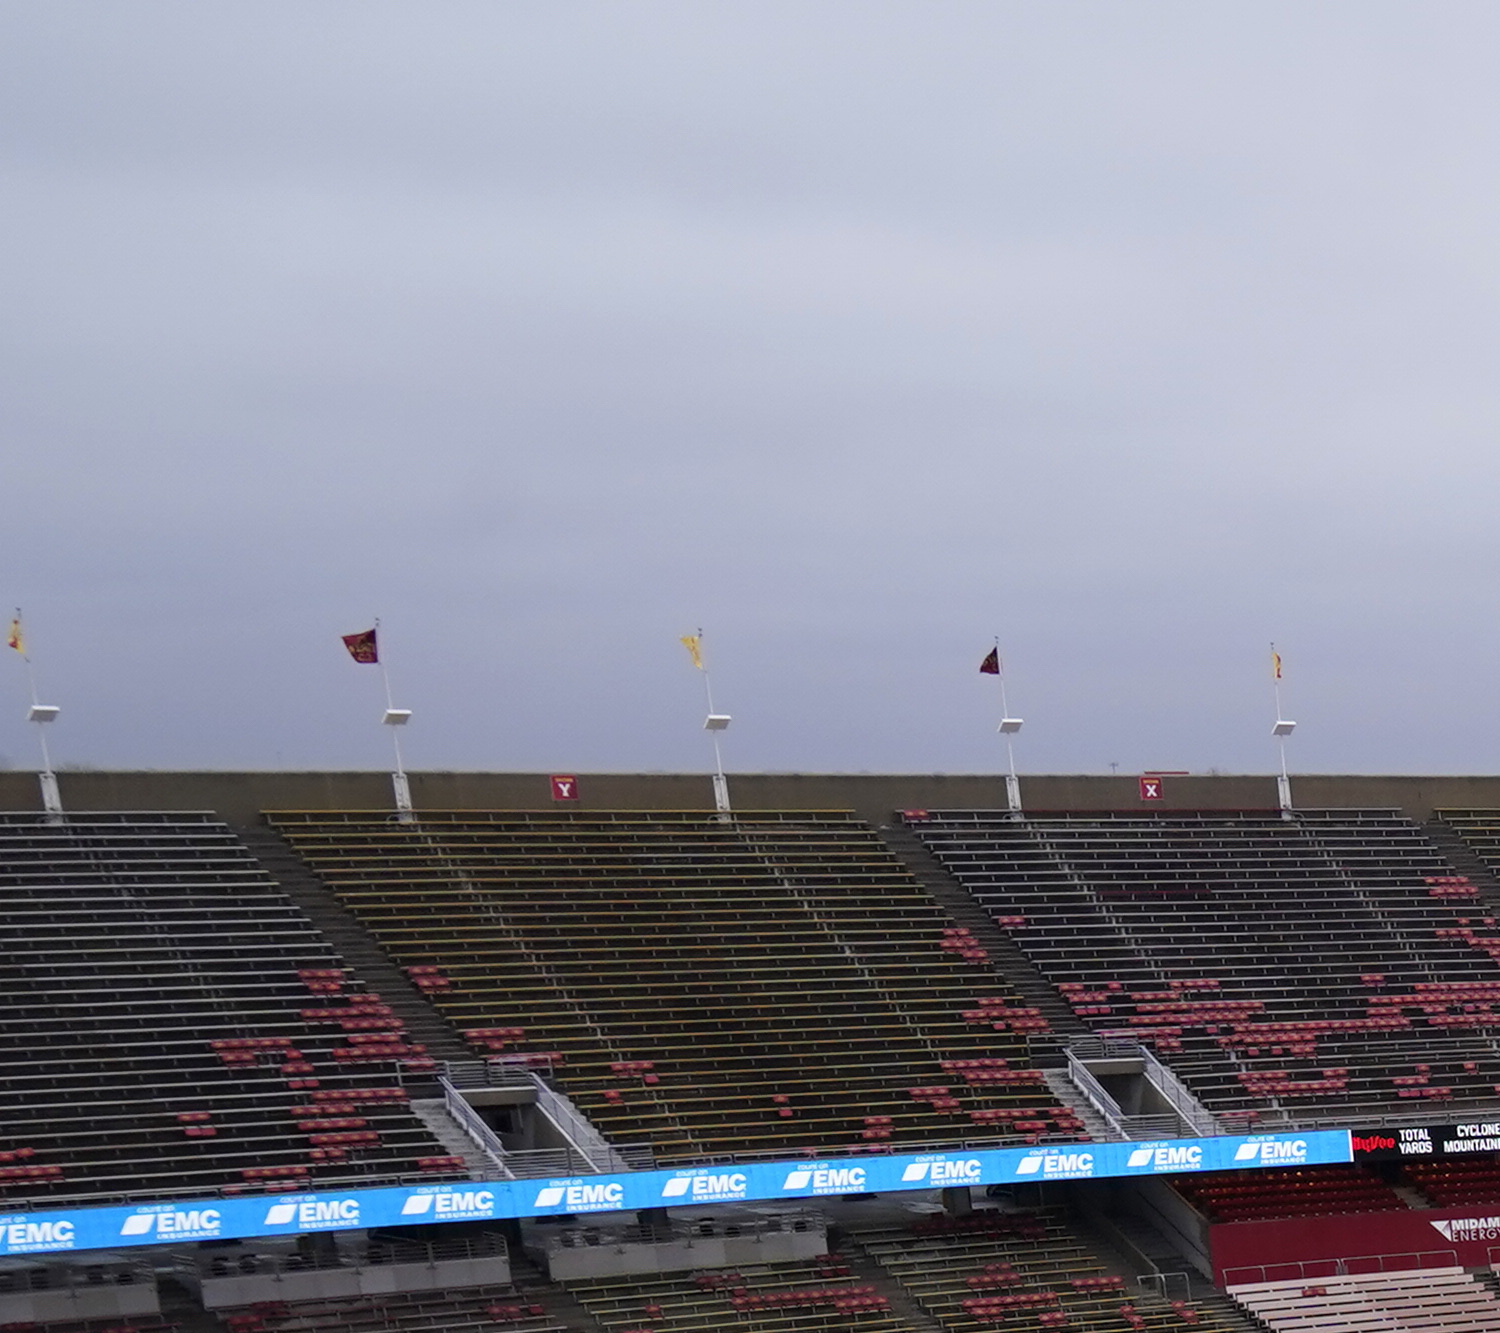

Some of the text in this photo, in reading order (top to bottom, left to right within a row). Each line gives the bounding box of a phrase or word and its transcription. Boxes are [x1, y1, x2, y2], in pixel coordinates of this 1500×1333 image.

[1399, 1129, 1431, 1143] TOTAL
[1399, 1141, 1433, 1155] YARDS
[931, 1159, 981, 1179] EMC
[1044, 1153, 1093, 1172] EMC
[693, 1173, 747, 1194] EMC
[813, 1167, 866, 1188] EMC
[435, 1191, 494, 1212] EMC
[567, 1184, 623, 1205] EMC
[156, 1210, 221, 1232] EMC
[299, 1199, 360, 1222] EMC
[8, 1221, 75, 1244] EMC
[300, 1219, 359, 1229] INSURANCE
[156, 1230, 221, 1240] INSURANCE
